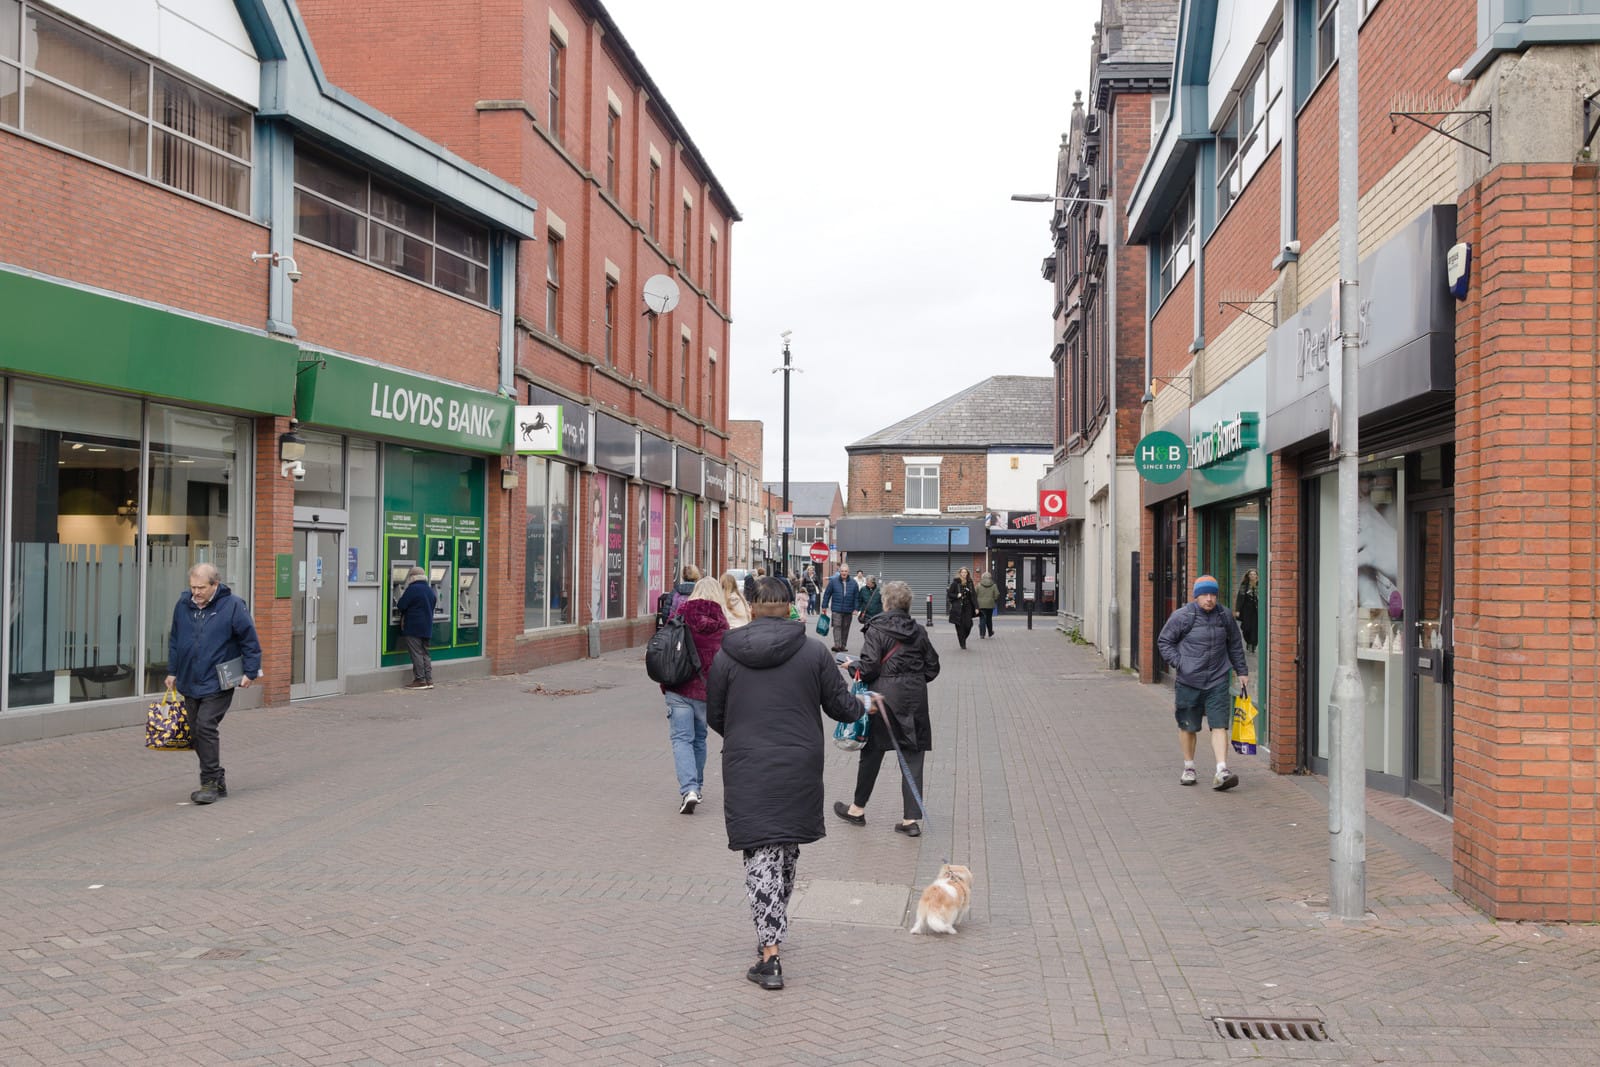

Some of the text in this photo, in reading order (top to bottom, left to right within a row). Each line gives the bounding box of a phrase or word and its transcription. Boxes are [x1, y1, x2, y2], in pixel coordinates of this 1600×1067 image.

[370, 382, 495, 438] LLOYDS BANK
[1142, 446, 1180, 461] H&B
[1192, 427, 1213, 470] Holland
[1218, 412, 1242, 458] Barrett
[1013, 514, 1037, 529] THE
